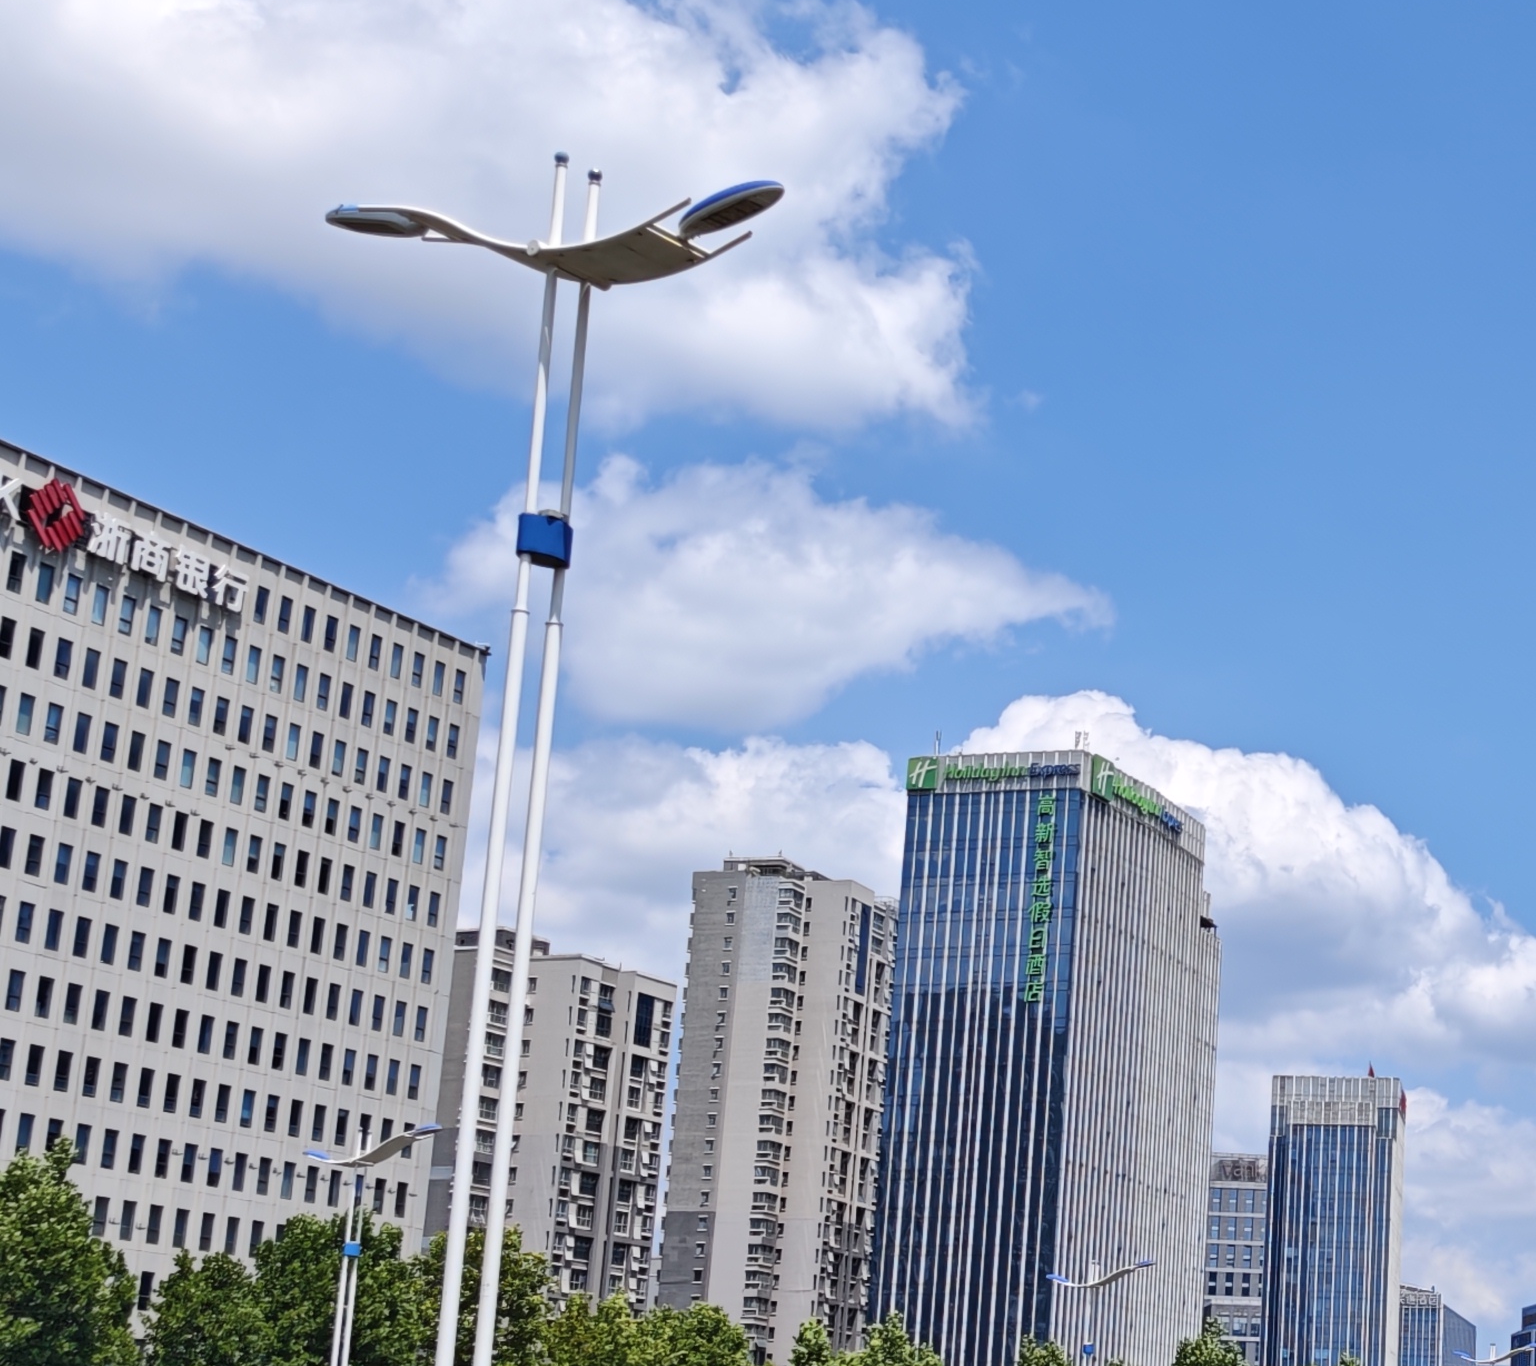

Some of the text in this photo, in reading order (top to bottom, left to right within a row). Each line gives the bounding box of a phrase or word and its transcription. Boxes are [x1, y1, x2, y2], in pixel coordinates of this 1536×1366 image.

[88, 510, 249, 613] 浙商银行
[1023, 793, 1056, 1003] 高新智选假日酒店
